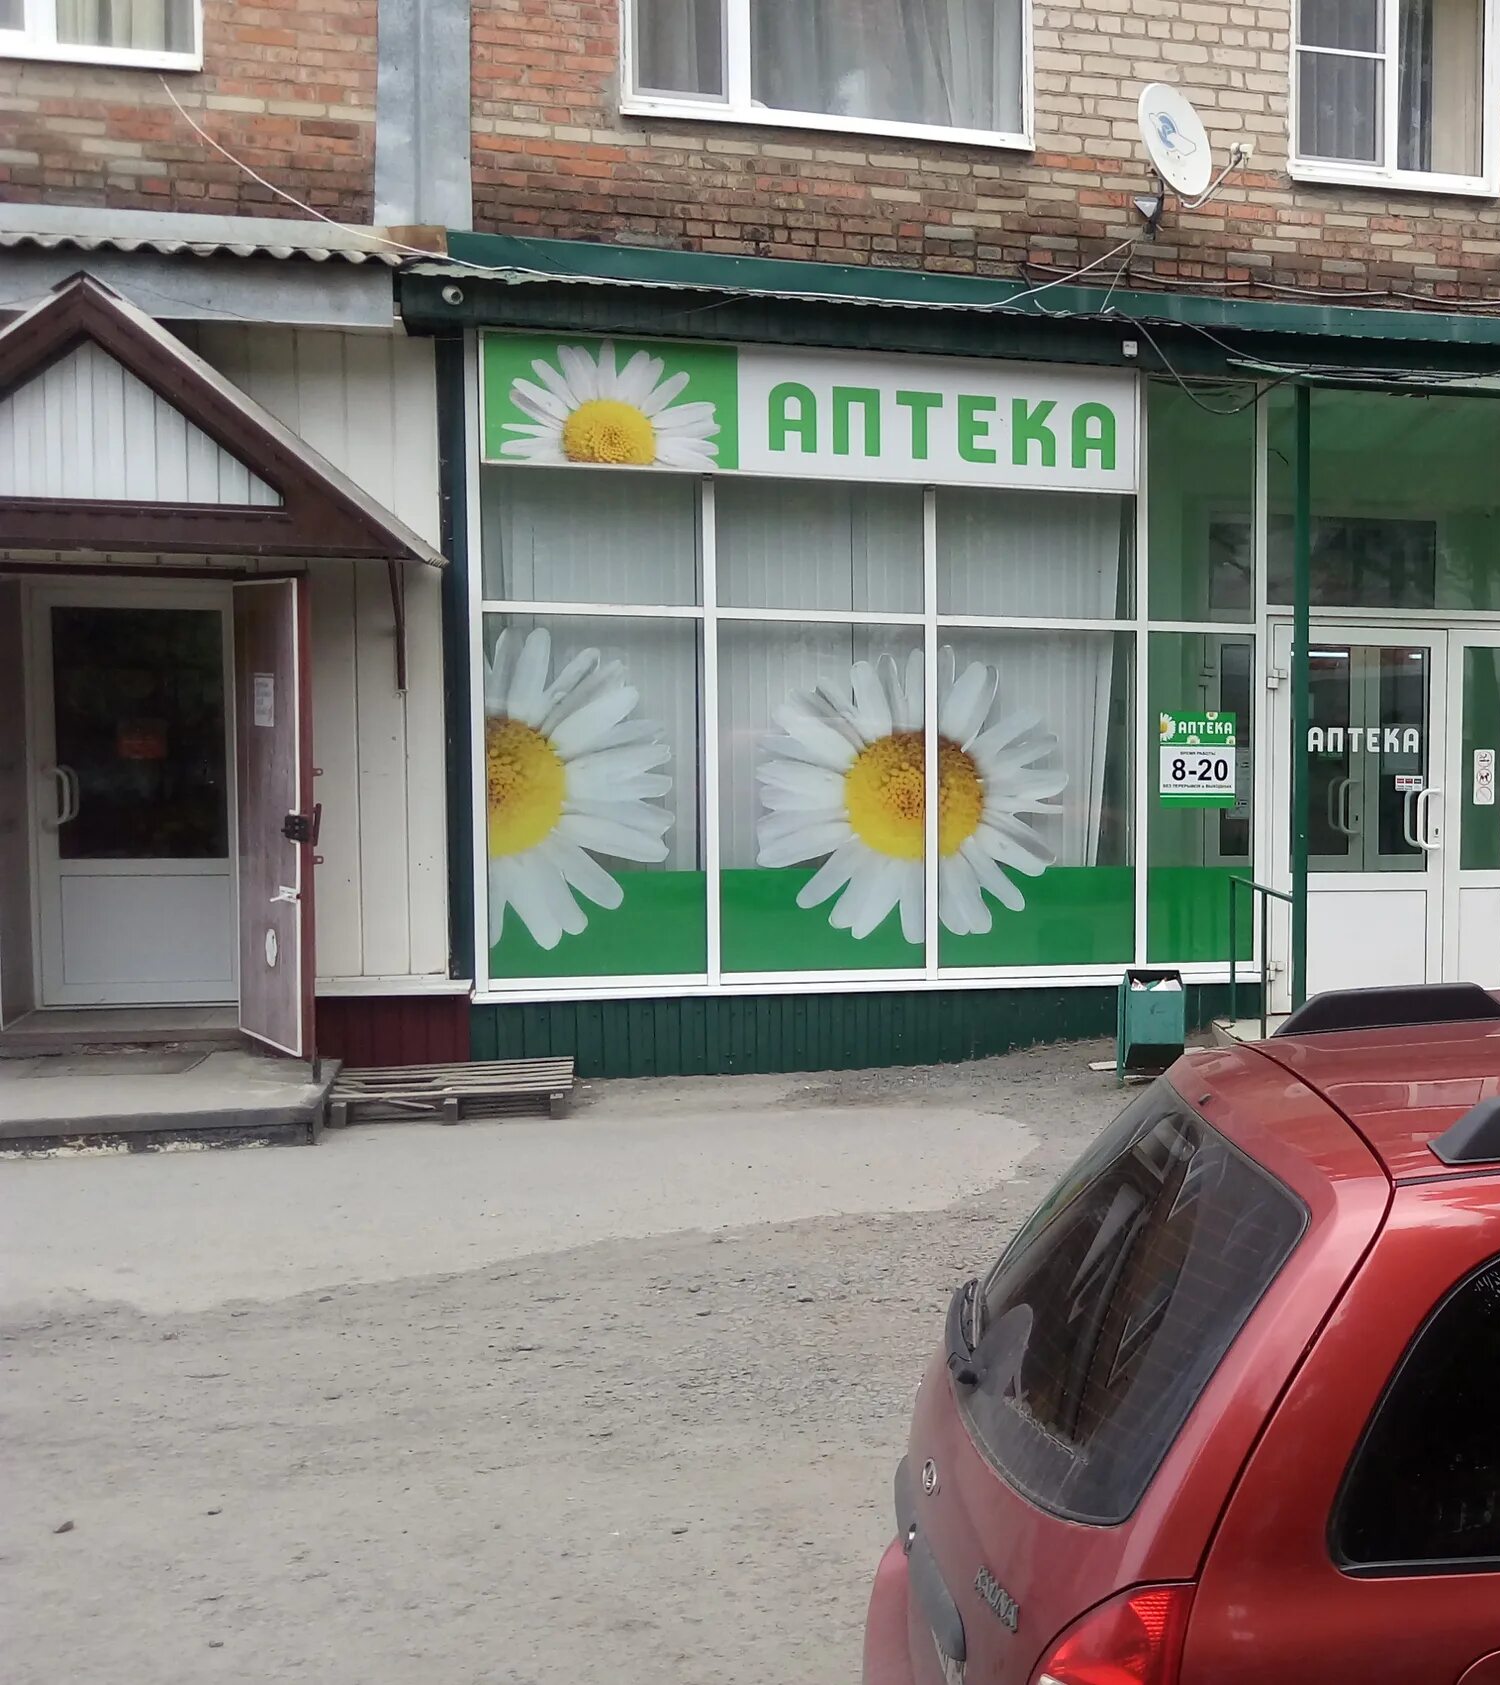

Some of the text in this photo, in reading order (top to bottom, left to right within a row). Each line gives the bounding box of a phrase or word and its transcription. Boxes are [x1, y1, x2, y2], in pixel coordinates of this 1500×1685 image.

[768, 382, 1115, 470] АПТЕКА
[1178, 721, 1232, 735] АПТЕКА
[1307, 727, 1420, 753] АПТЕКА
[1172, 758, 1228, 781] 8-20
